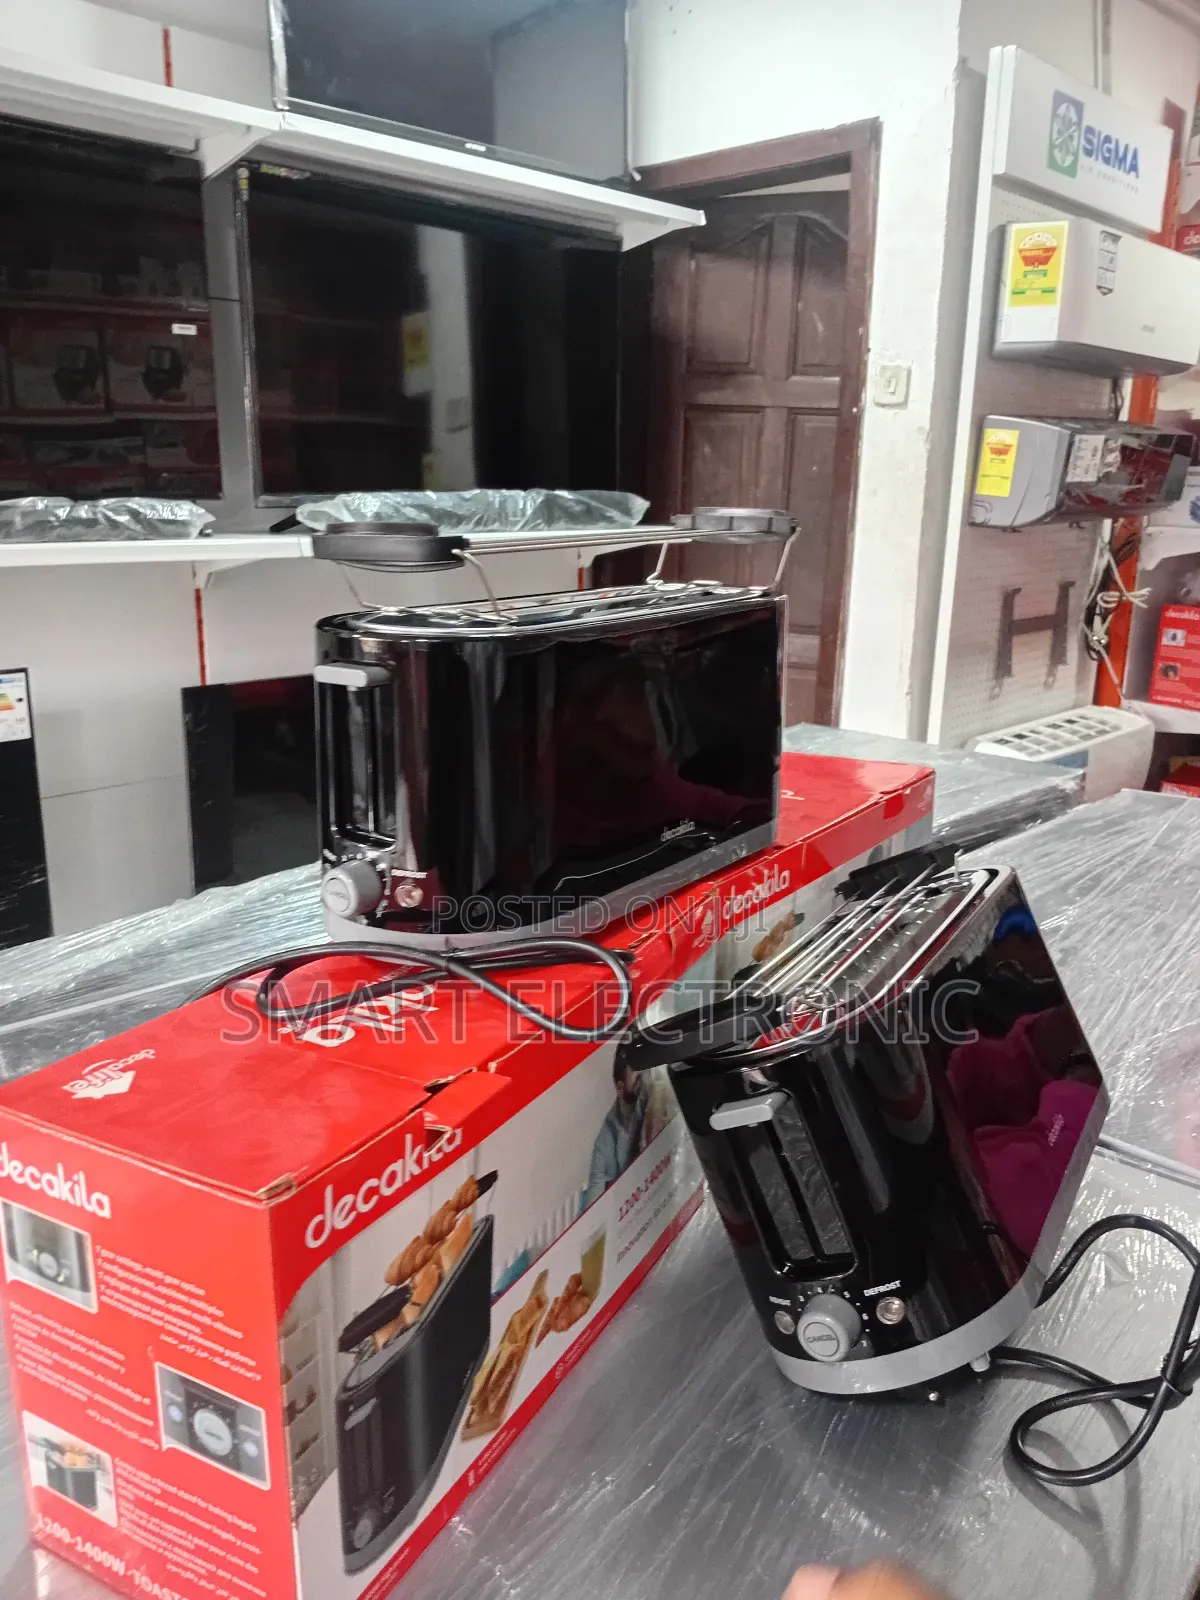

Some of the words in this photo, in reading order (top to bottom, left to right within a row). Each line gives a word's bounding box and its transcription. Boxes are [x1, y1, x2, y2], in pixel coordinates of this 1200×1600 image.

[1082, 124, 1140, 178] SIGMA
[723, 864, 790, 919] decakila
[863, 1280, 902, 1297] DEFROST
[31, 1512, 126, 1577] 1200-1400W
